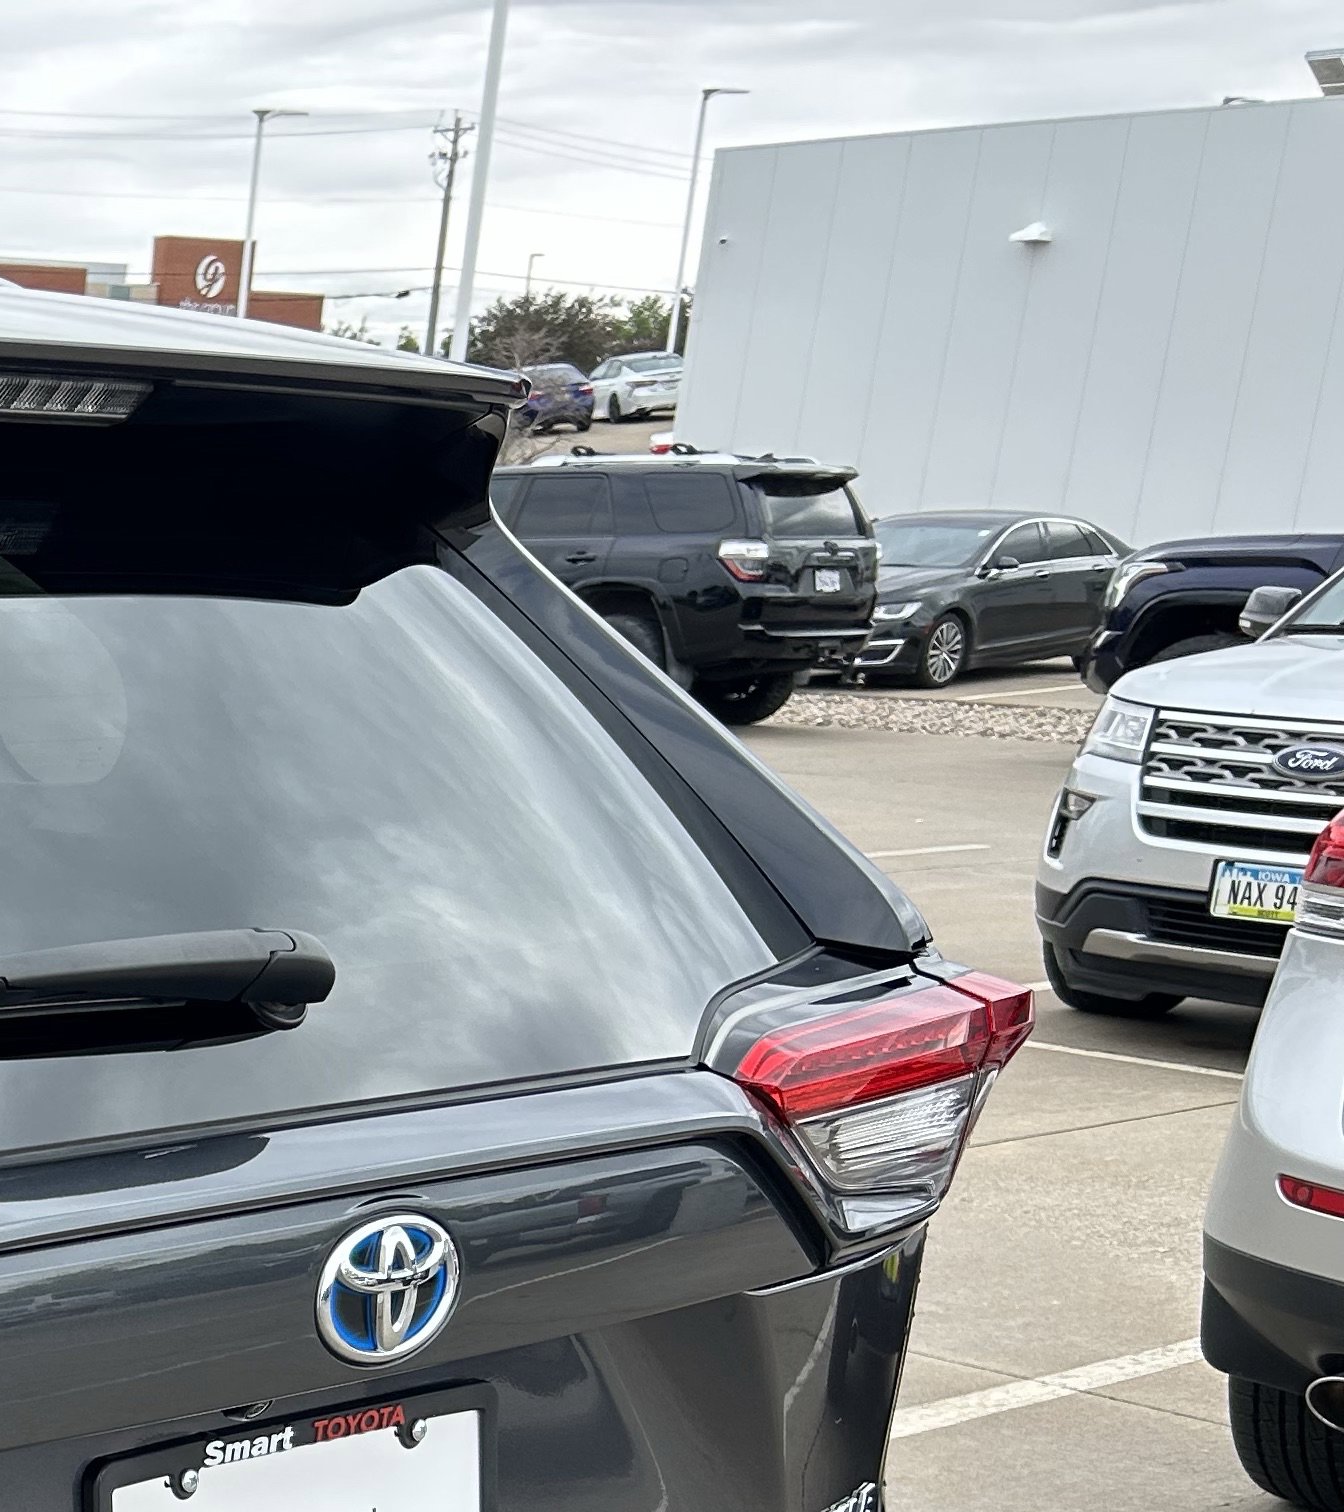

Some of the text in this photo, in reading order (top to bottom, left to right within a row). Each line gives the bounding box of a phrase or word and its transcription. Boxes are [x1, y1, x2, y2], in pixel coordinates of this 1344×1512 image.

[1287, 751, 1338, 771] Ford
[1258, 871, 1290, 883] IOWA
[1228, 880, 1267, 908] NAX
[203, 1404, 406, 1467] Smart TOYOTA
